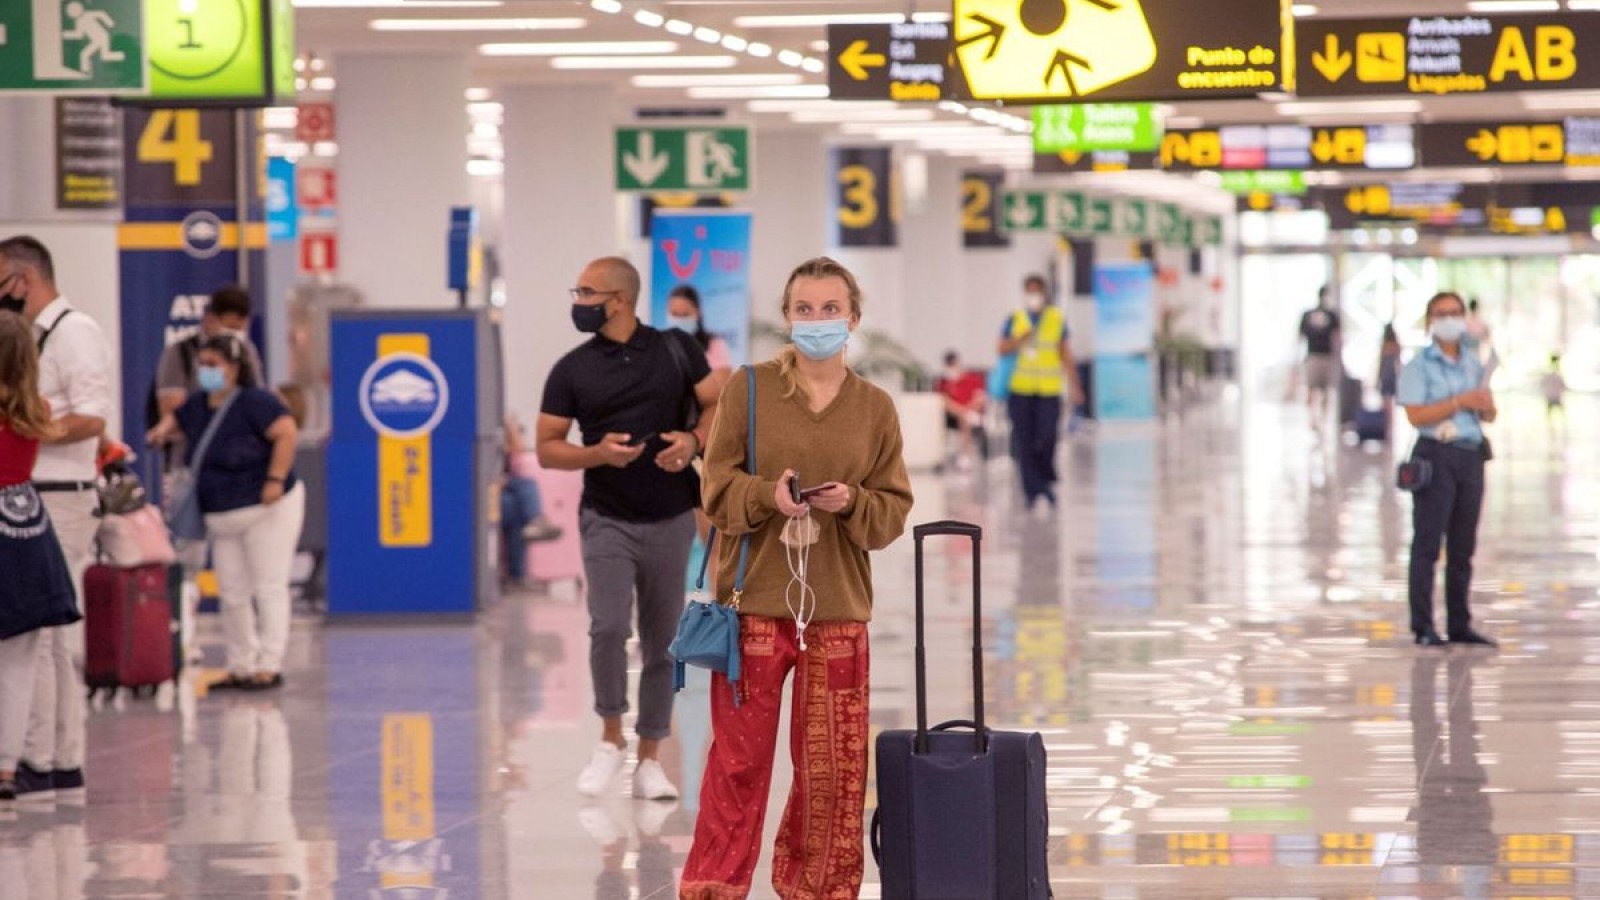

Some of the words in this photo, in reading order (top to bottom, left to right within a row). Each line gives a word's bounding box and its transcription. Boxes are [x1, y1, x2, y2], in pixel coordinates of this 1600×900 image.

[1178, 68, 1275, 88] encuentro
[1187, 47, 1245, 66] Punto
[1248, 45, 1275, 65] de
[1489, 25, 1577, 82] AB
[137, 109, 213, 184] 4
[839, 165, 877, 229] 3
[961, 179, 991, 231] 2
[170, 295, 212, 319] AT
